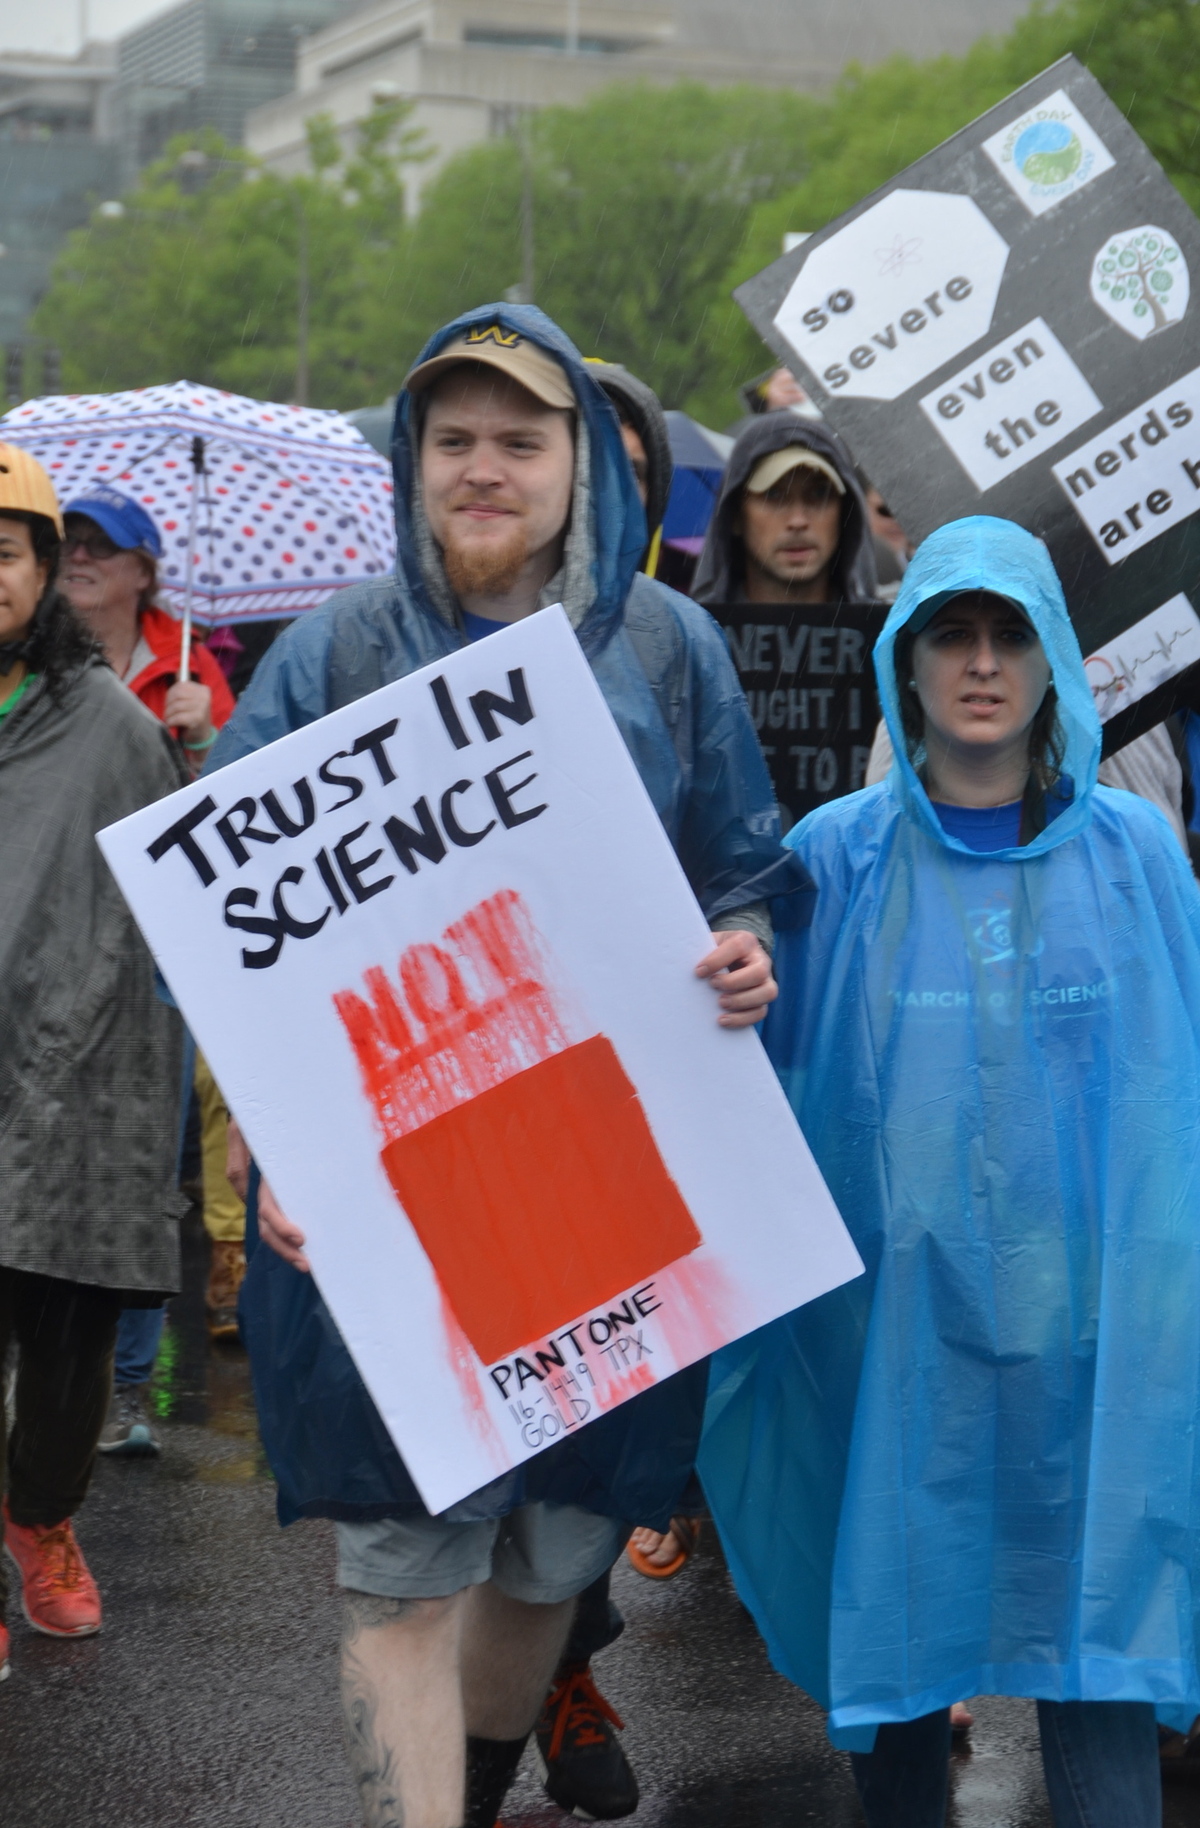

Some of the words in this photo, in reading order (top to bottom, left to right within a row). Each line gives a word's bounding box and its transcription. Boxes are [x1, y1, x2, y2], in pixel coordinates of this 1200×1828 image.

[1036, 109, 1073, 121] DAY
[802, 287, 854, 333] so
[823, 274, 974, 390] severe
[937, 337, 1045, 419] even
[984, 399, 1062, 459] the
[1065, 400, 1194, 498] nerds
[1099, 488, 1173, 548] are
[725, 623, 865, 675] NEVER
[146, 717, 400, 888] TRUST
[429, 667, 536, 750] IN
[790, 745, 839, 793] TO
[224, 750, 549, 969] SCIENCE
[488, 1281, 663, 1400] PANTONE
[509, 1362, 596, 1425] 16-1449
[599, 1329, 653, 1371] TPX
[521, 1398, 592, 1448] GOLD
